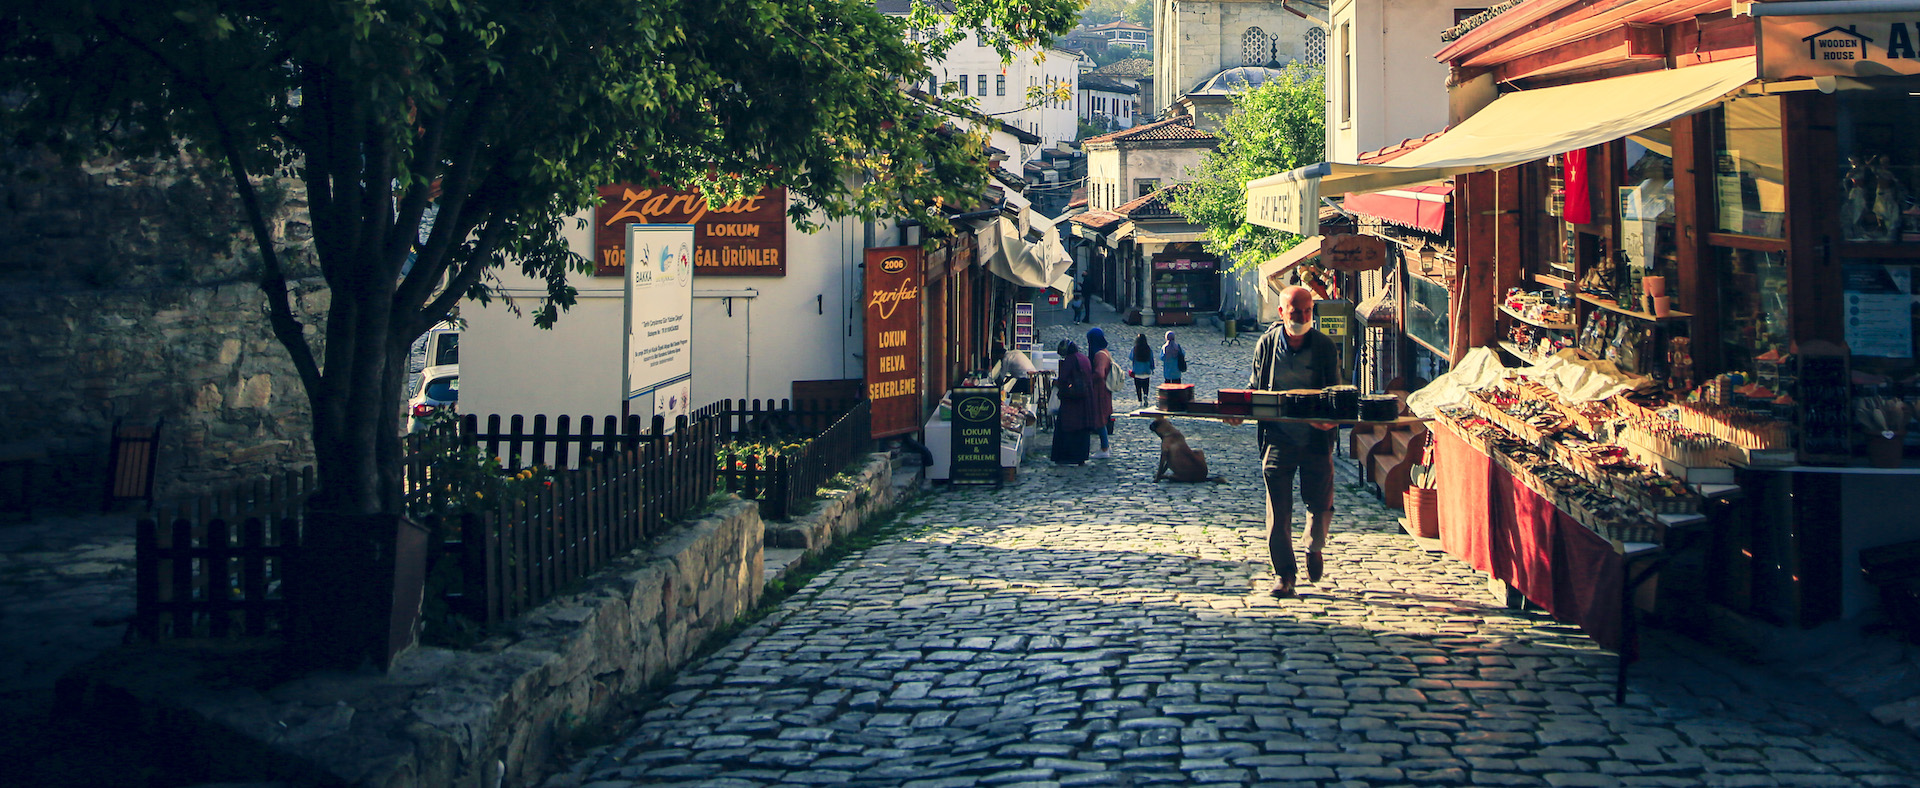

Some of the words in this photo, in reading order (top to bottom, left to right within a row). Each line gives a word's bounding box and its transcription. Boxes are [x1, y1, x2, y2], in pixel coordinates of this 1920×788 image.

[1818, 39, 1857, 48] WOODEN
[1887, 21, 1920, 59] A
[1823, 51, 1854, 60] HOUSE
[706, 223, 760, 238] LOKUM
[721, 245, 779, 267] ÜRÜNLER
[884, 259, 904, 270] 2006
[635, 271, 652, 283] BAKKA
[878, 330, 907, 348] LOKUM
[879, 355, 906, 373] HELVA
[869, 378, 916, 403] ŞEKERLEME
[962, 428, 992, 436] LOKUM
[964, 437, 989, 445] HELVA
[957, 454, 996, 462] ŞEKERLEME
